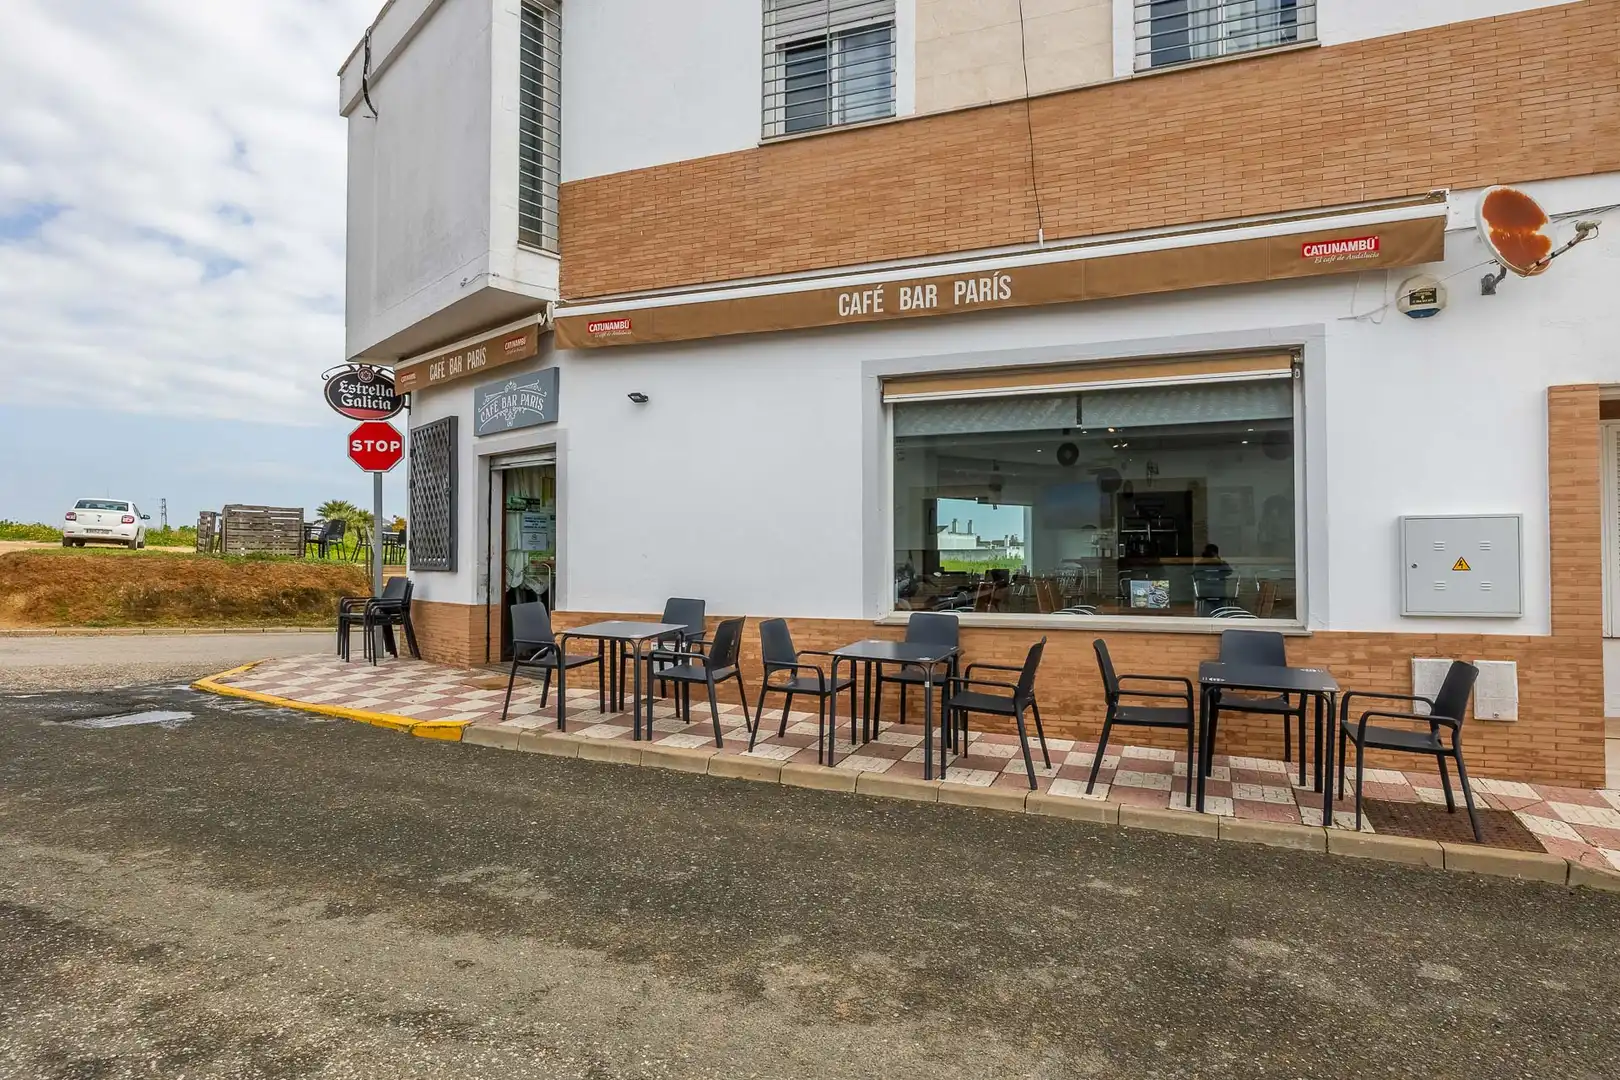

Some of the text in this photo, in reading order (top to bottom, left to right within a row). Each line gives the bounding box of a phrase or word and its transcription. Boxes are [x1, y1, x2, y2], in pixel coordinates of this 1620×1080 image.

[838, 271, 1012, 317] CAFÉ BAR PARÍS
[449, 355, 463, 375] BAR
[338, 380, 394, 398] Estrella
[341, 393, 391, 410] Galicia
[501, 394, 518, 409] BAR
[352, 440, 401, 452] STOP
